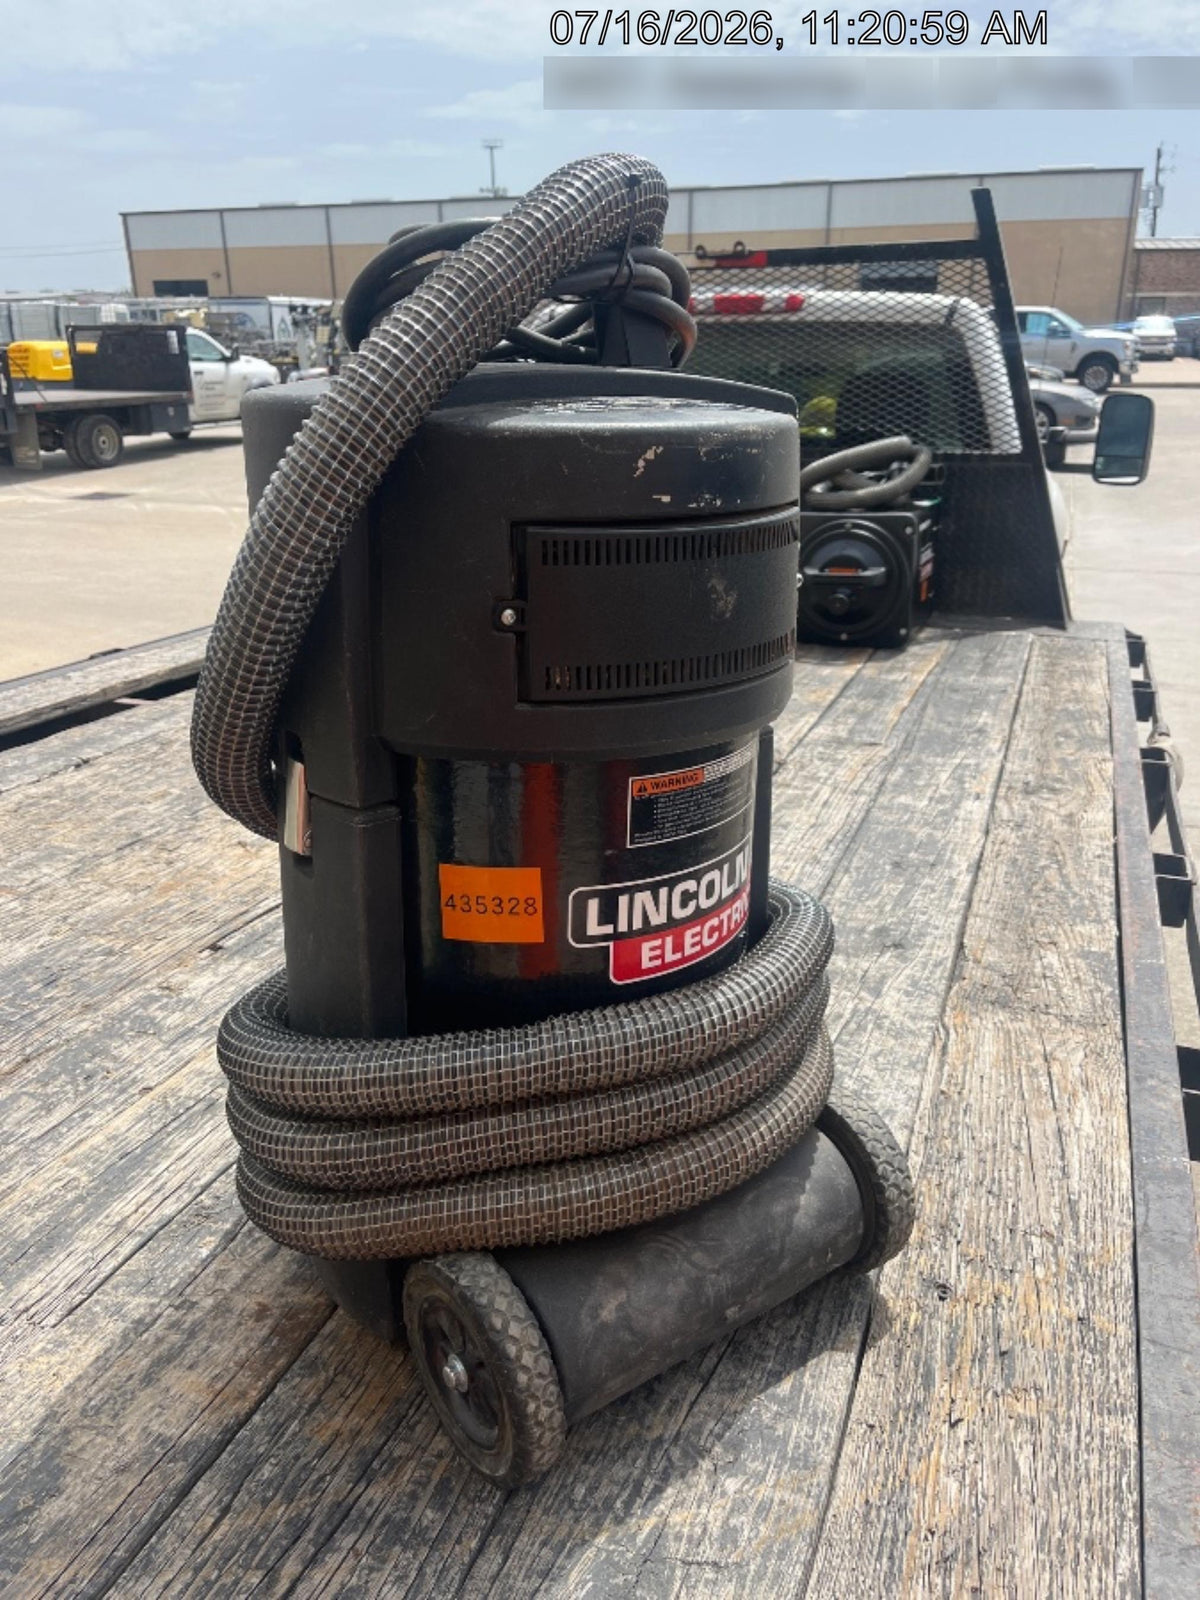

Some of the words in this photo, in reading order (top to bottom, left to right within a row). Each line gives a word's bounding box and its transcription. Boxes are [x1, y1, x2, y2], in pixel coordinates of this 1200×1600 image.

[650, 772, 699, 790] WARNING
[585, 844, 750, 936] LINCOLN
[445, 893, 538, 916] 435328
